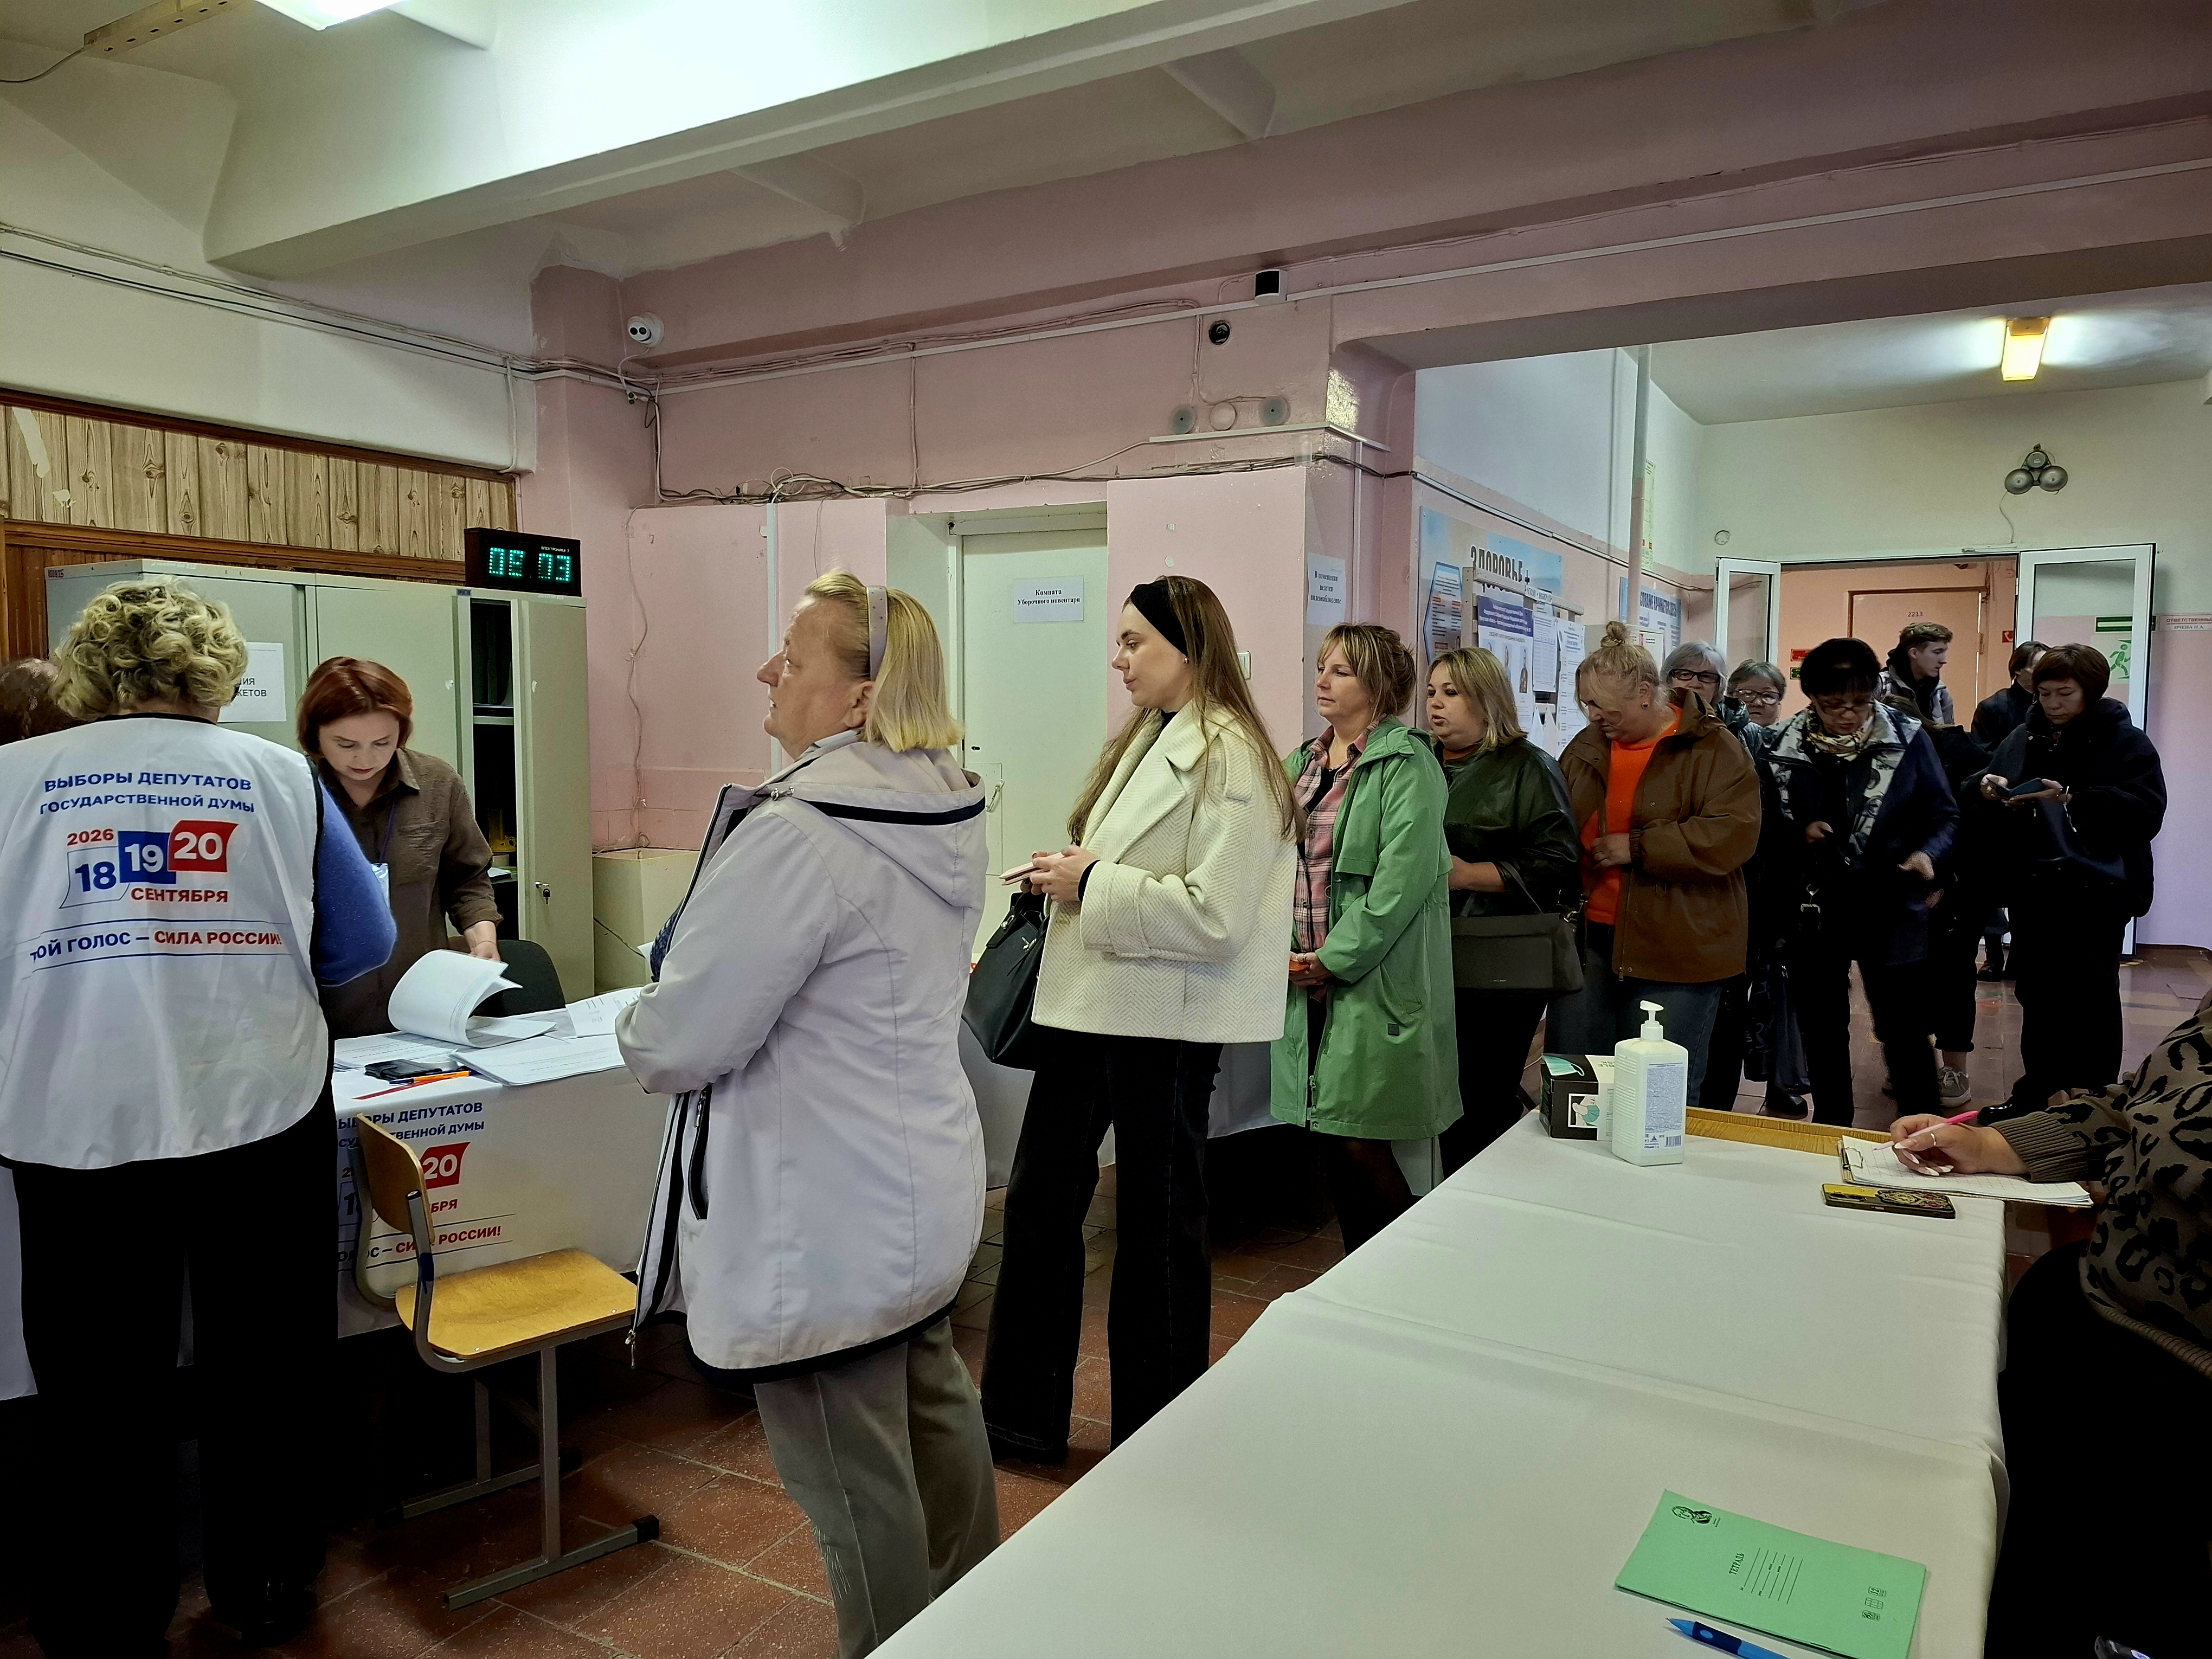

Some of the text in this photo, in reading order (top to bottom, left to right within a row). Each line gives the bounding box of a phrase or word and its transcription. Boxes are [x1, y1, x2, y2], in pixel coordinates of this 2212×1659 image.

[1017, 599, 1050, 607] Уборочного
[44, 772, 252, 792] ВЫБОРЫ ДЕПУТАТОВ
[40, 794, 254, 814] ГОСУДАРСТВЕННОЙ ДУМЫ
[67, 828, 114, 846] 2026
[75, 832, 223, 892] 18 19 20
[131, 888, 228, 902] СЕНТЯБРЯ
[67, 932, 131, 953] ГОЛОС
[155, 930, 202, 944] СИЛА
[207, 931, 282, 945] РОССИИ!
[397, 1102, 483, 1124] ДЕПУТАТОВ
[448, 1121, 485, 1136] ДУМЫ
[422, 1154, 458, 1180] 20
[439, 1226, 501, 1245] РОССИИ!
[1728, 1552, 1745, 1575] ТЕТРАДЬ
